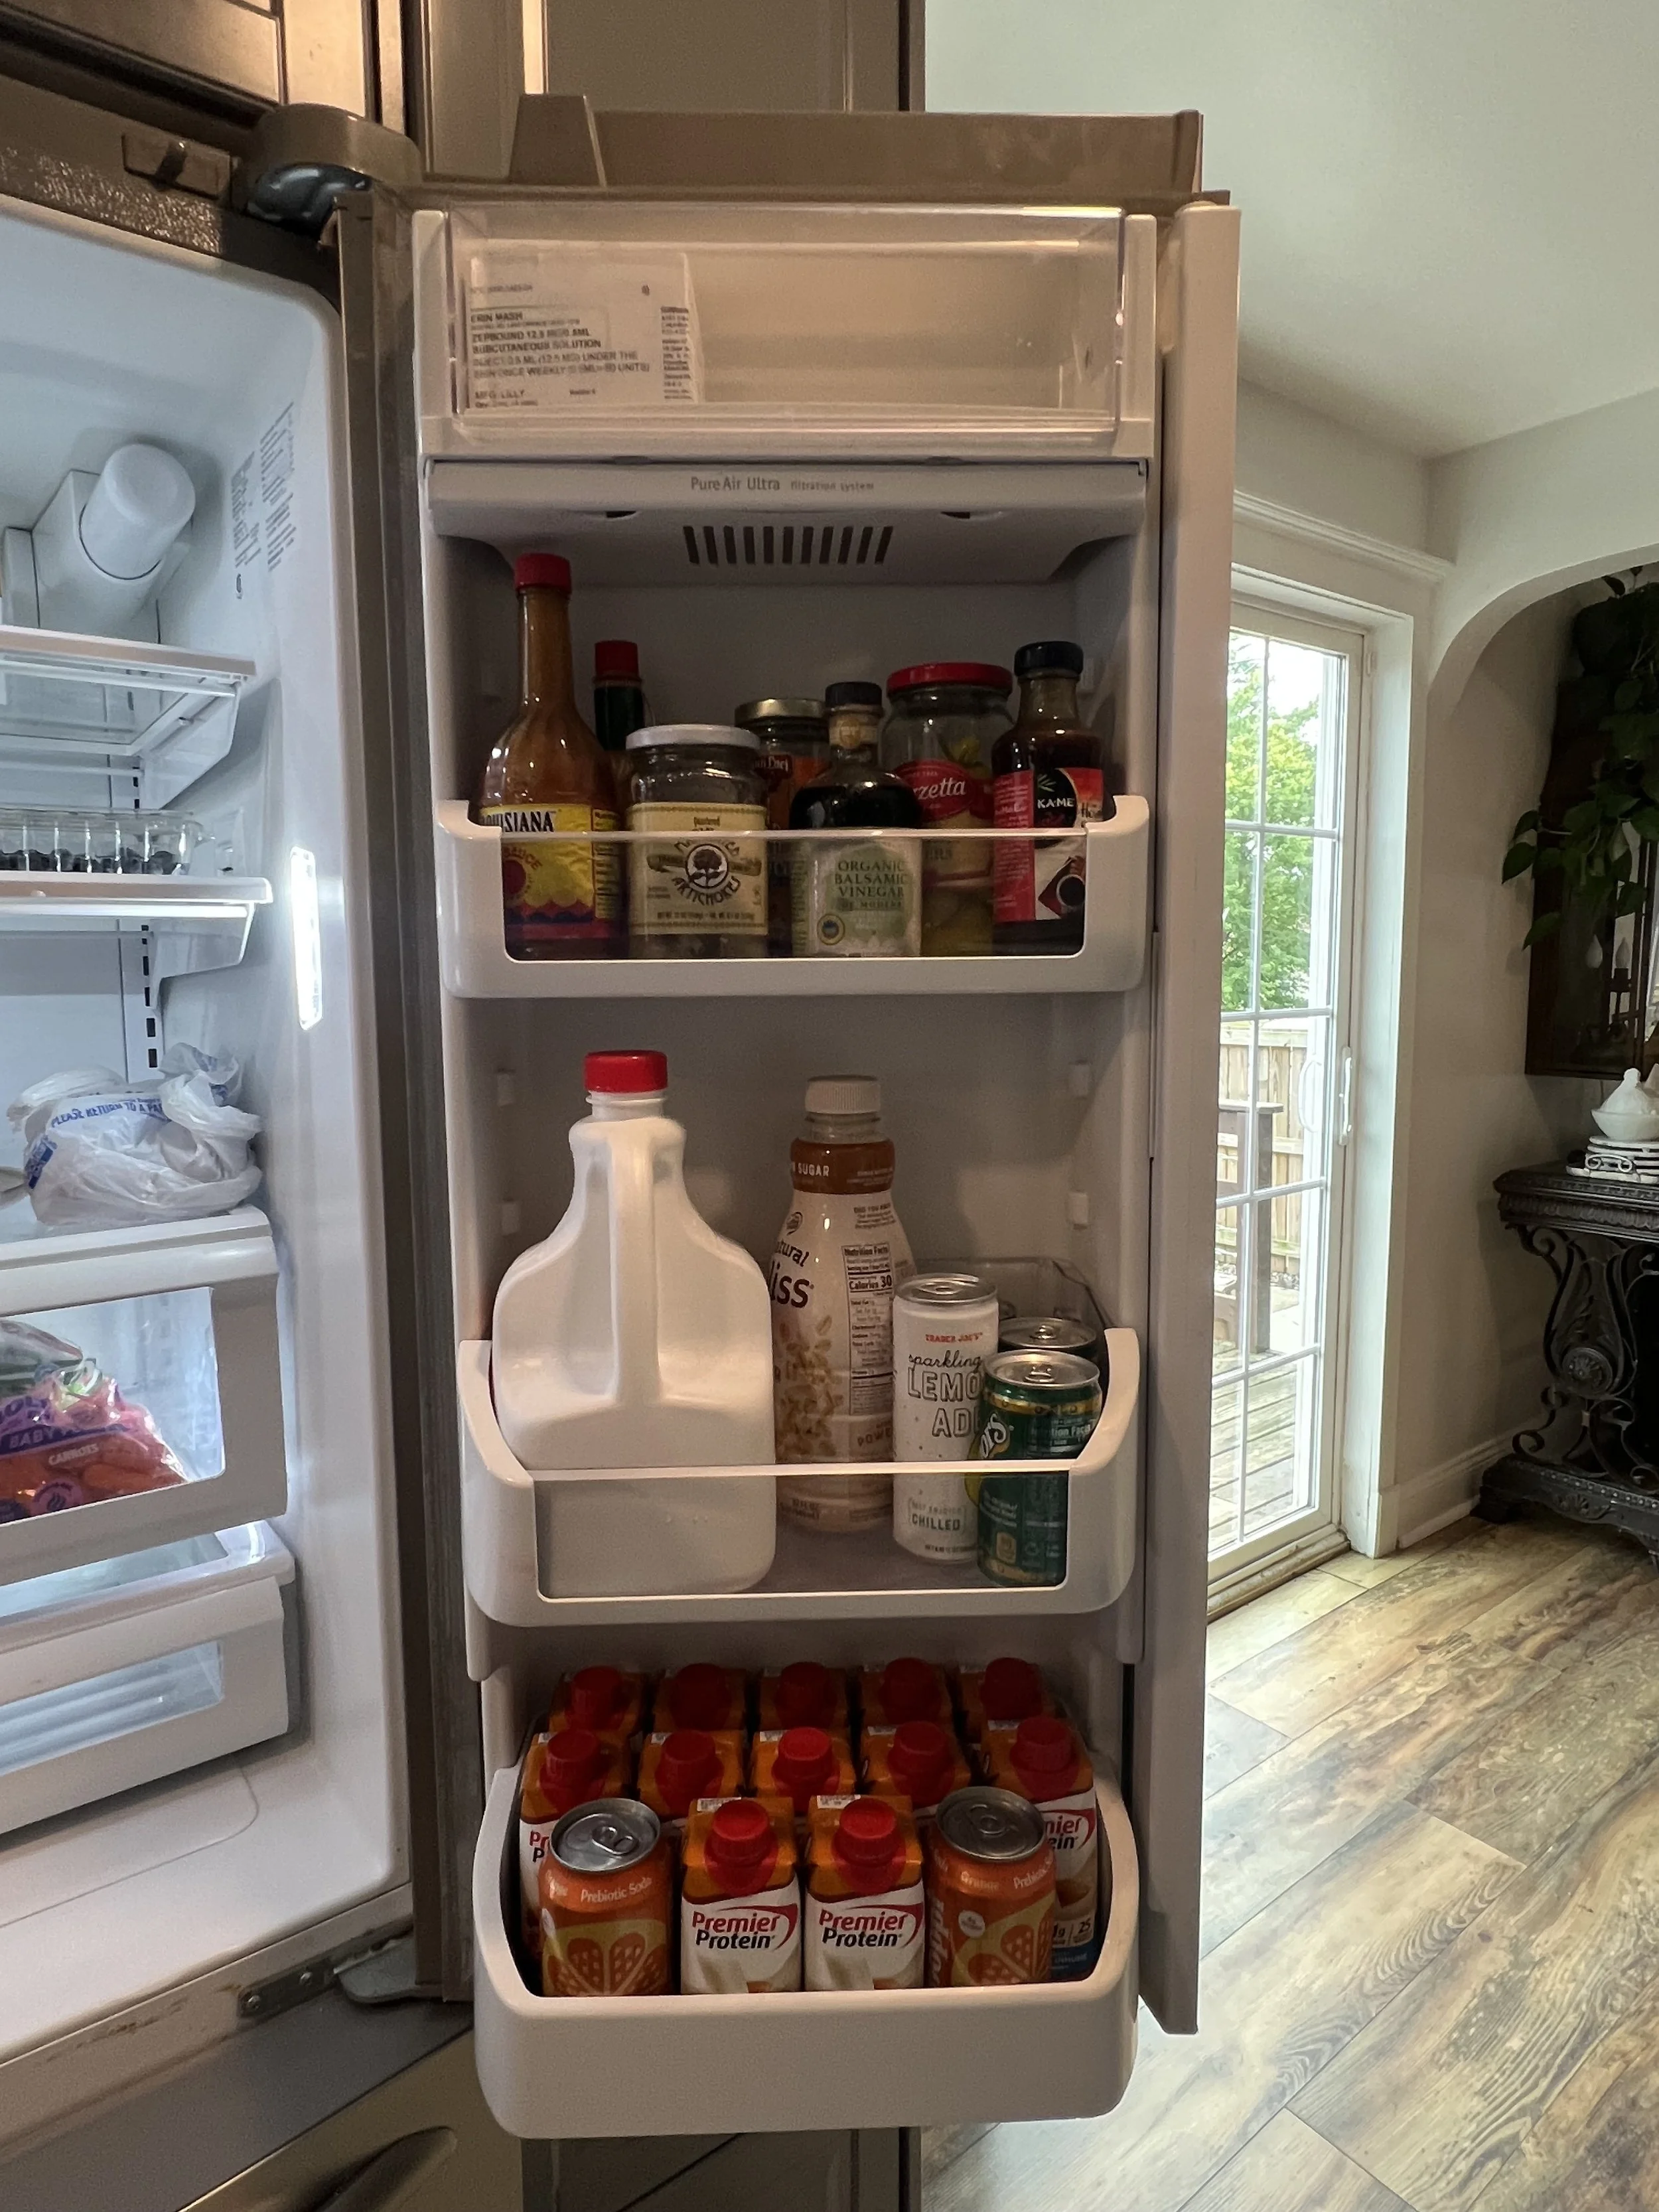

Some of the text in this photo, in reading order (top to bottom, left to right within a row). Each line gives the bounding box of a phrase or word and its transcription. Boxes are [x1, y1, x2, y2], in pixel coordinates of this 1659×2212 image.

[747, 476, 780, 491] Ultra
[913, 777, 966, 800] zetta
[838, 859, 904, 872] ORGANIC
[835, 873, 907, 885] BALSAMIC
[839, 886, 904, 897] VINEGAR
[798, 1163, 830, 1177] SUGAR
[776, 1238, 810, 1268] tural
[880, 1274, 893, 1288] 30
[926, 1334, 956, 1343] TRADER
[908, 1350, 981, 1374] sparkling
[907, 1366, 983, 1402] LEMO
[980, 1413, 1007, 1458] ors
[912, 1513, 961, 1531] CHILLED
[581, 1886, 627, 1903] Prebiotic
[692, 1911, 780, 1933] Premier
[819, 1908, 908, 1931] Premier
[696, 1929, 772, 1950] Protein
[822, 1927, 898, 1948] Protein
